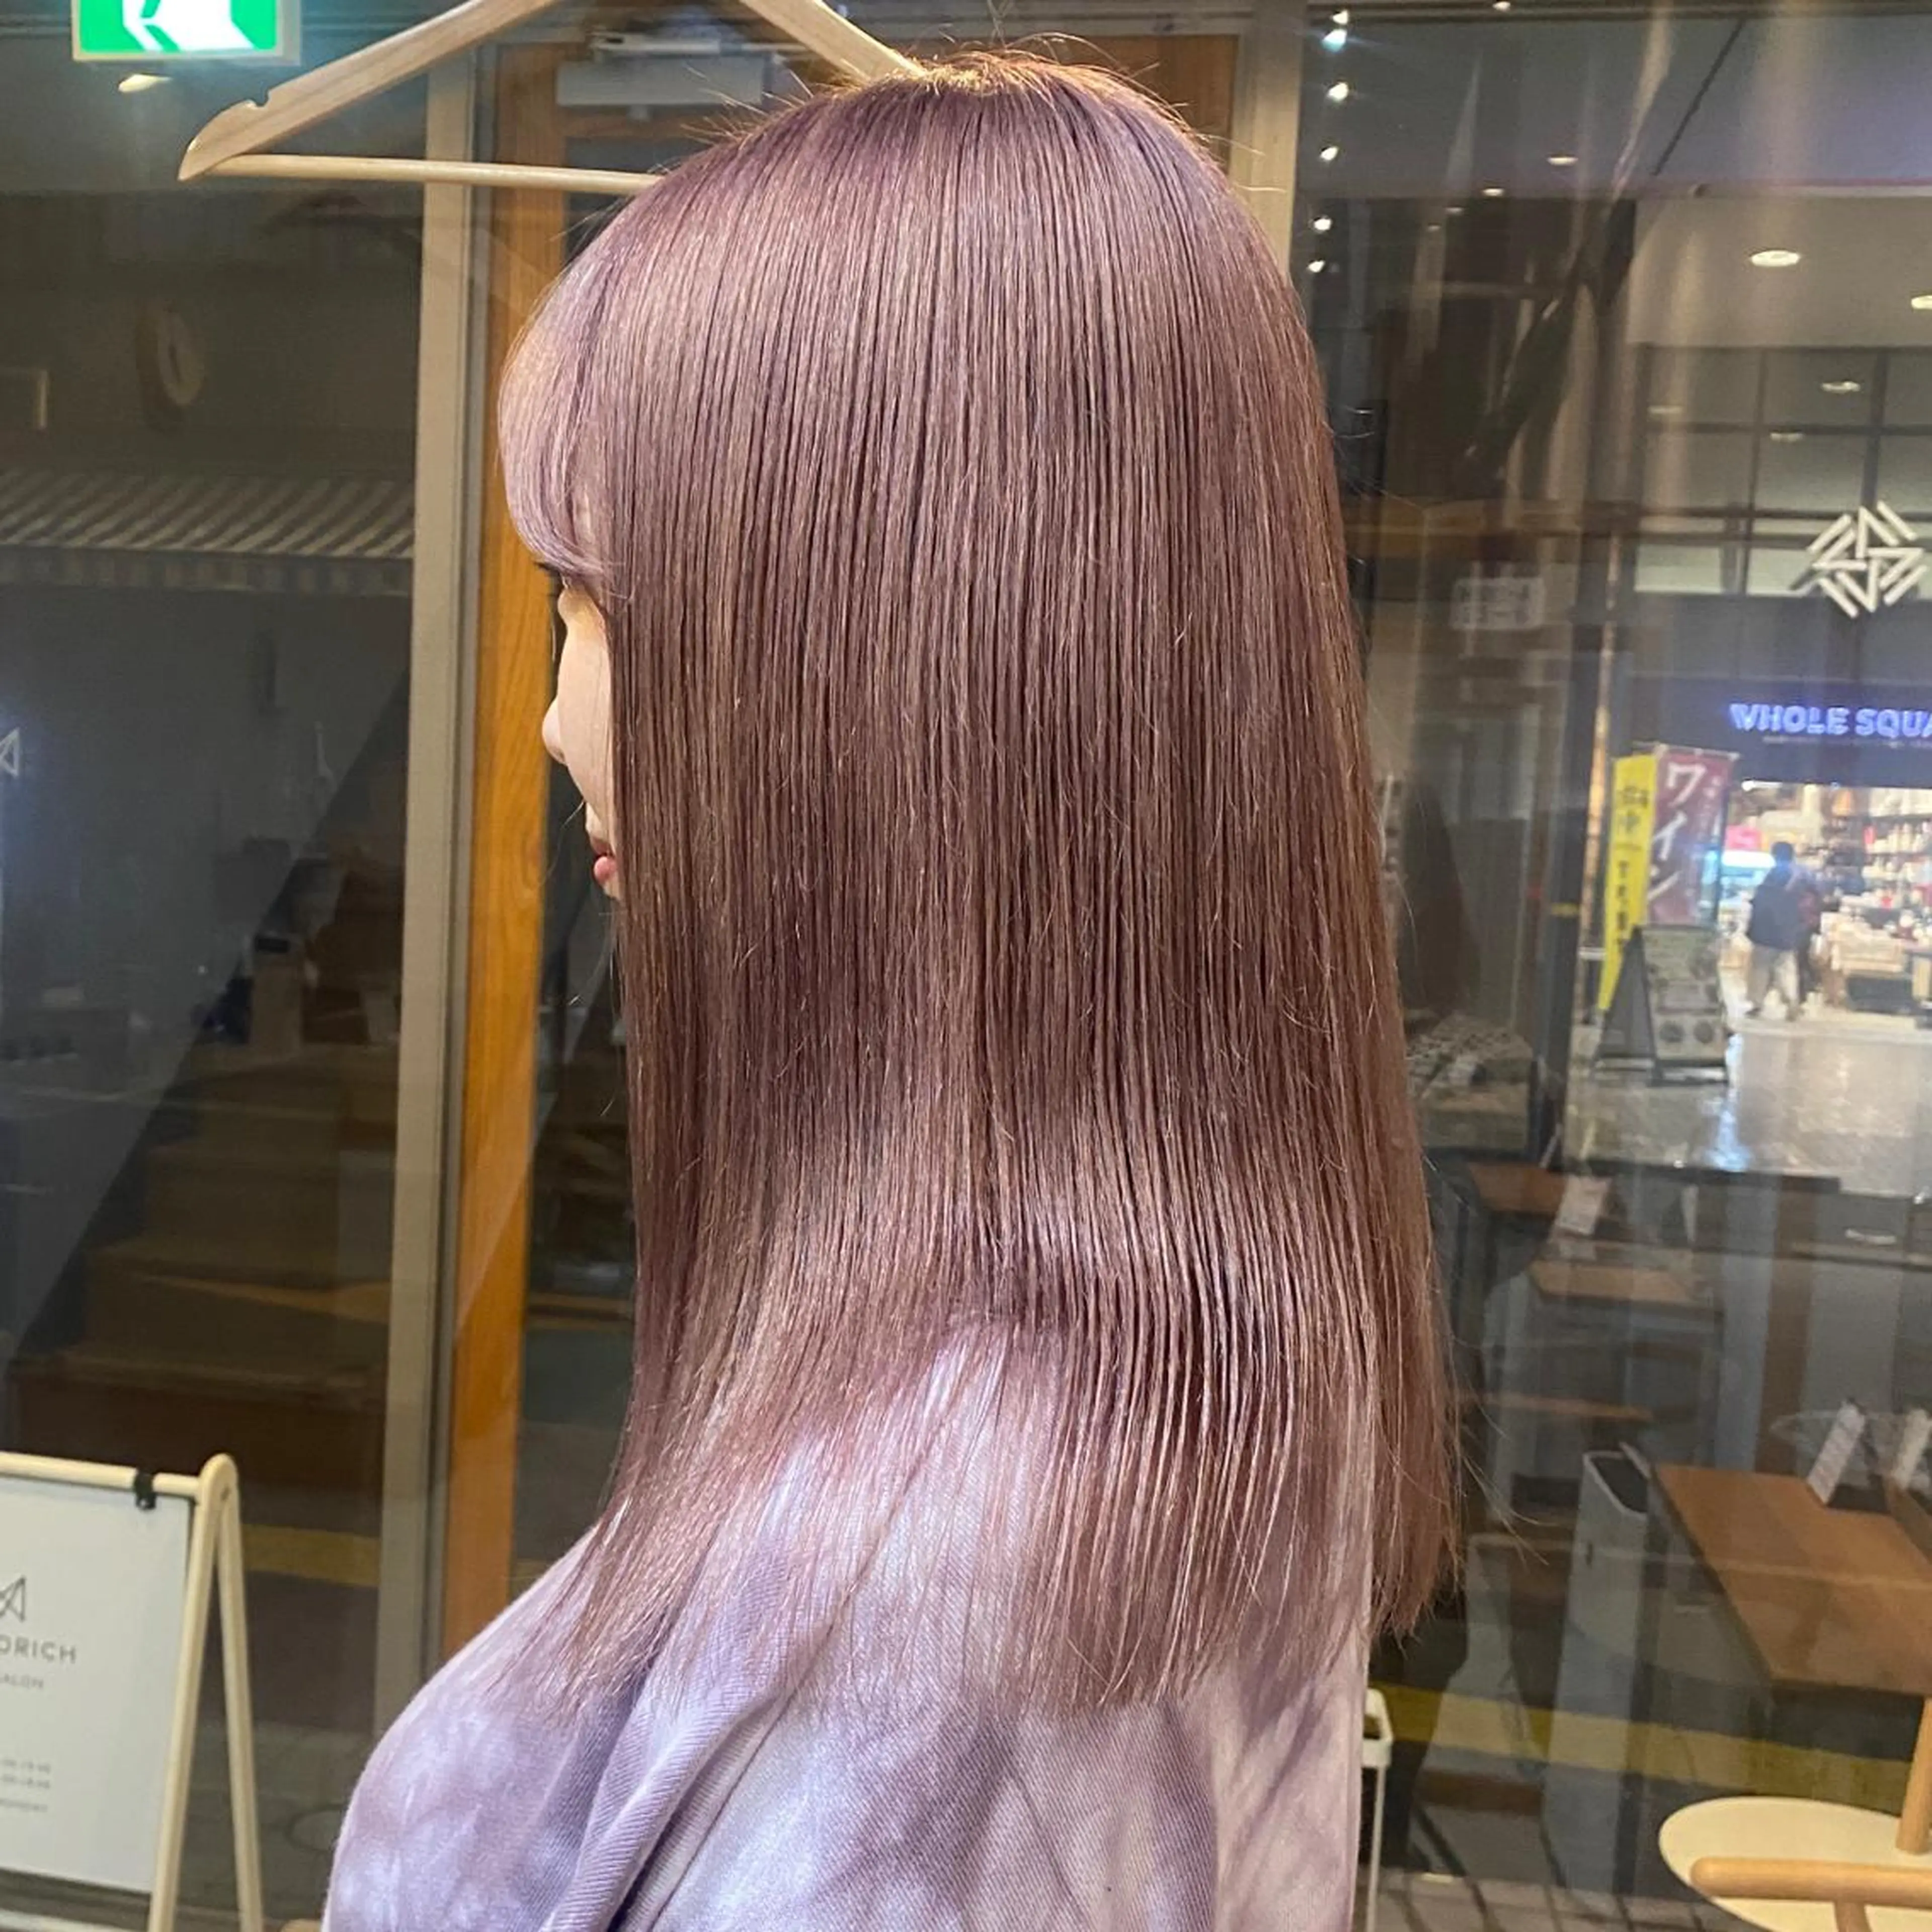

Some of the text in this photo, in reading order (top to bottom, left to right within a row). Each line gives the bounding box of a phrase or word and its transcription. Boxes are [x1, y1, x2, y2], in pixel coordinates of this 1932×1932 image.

[1730, 703, 1849, 735] WHOLE
[1648, 762, 1707, 901] ワイン
